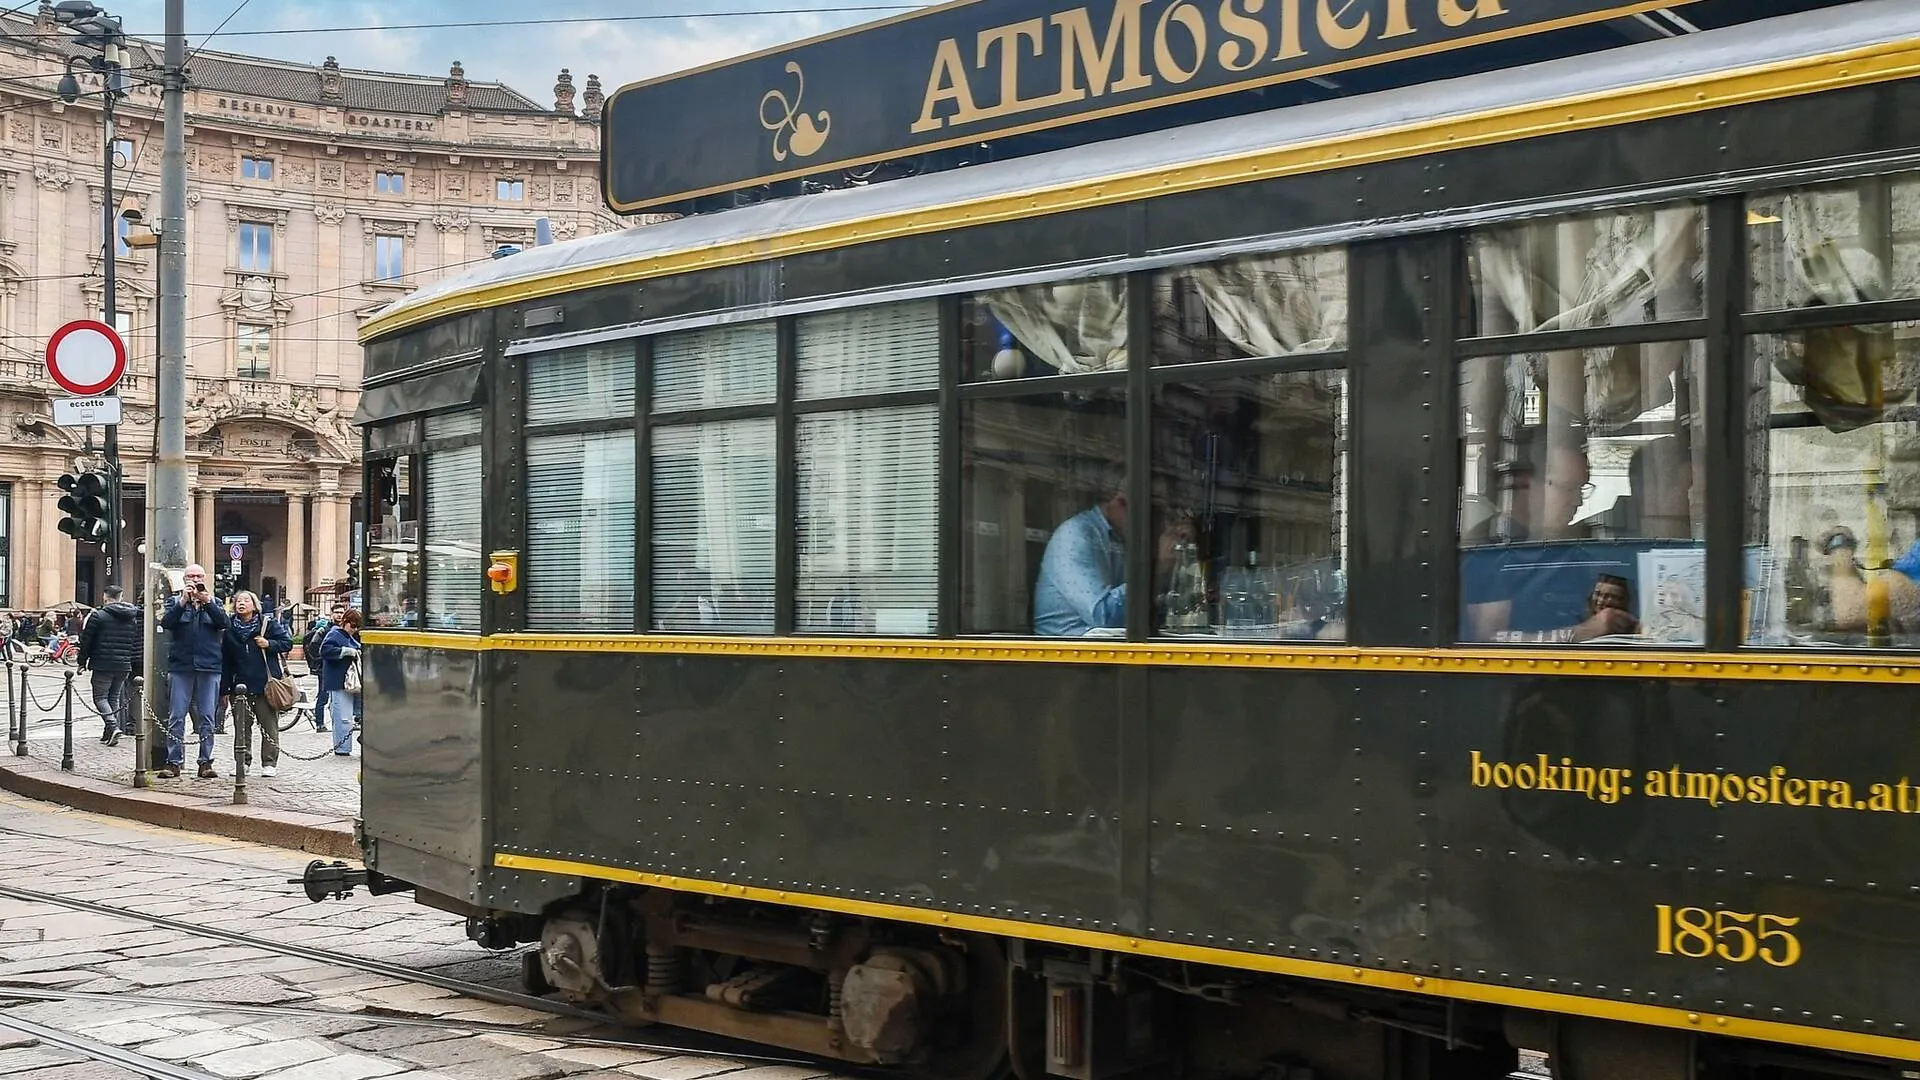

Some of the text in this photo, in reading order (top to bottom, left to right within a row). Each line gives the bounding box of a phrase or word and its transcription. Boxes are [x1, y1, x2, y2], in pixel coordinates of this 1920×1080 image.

[218, 98, 435, 132] RESERVE ROASTERY
[69, 400, 104, 408] eccetto
[240, 438, 272, 448] POSTE
[1469, 750, 1920, 814] booking: atmosfera.at
[1655, 904, 1801, 967] 1855
